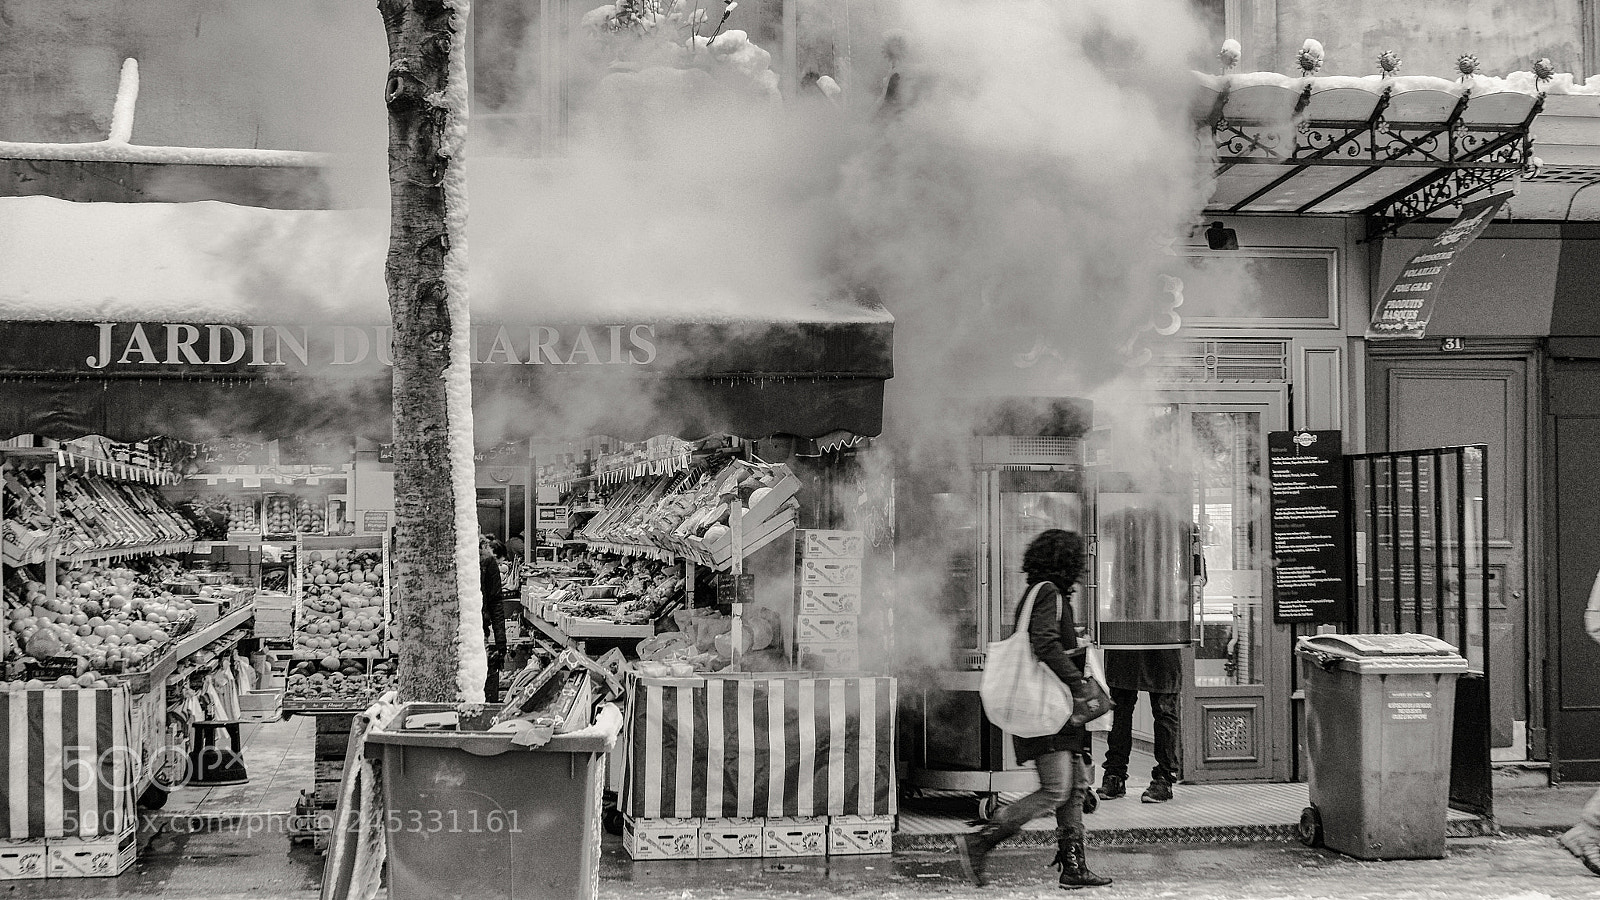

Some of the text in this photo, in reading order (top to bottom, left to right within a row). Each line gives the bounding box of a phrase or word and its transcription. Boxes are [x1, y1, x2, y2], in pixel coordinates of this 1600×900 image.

[1410, 282, 1433, 292] GRAS
[1384, 298, 1425, 309] PRODUITS
[1381, 309, 1419, 321] BASQUES
[86, 322, 309, 369] JARDIN
[1444, 338, 1461, 350] 31
